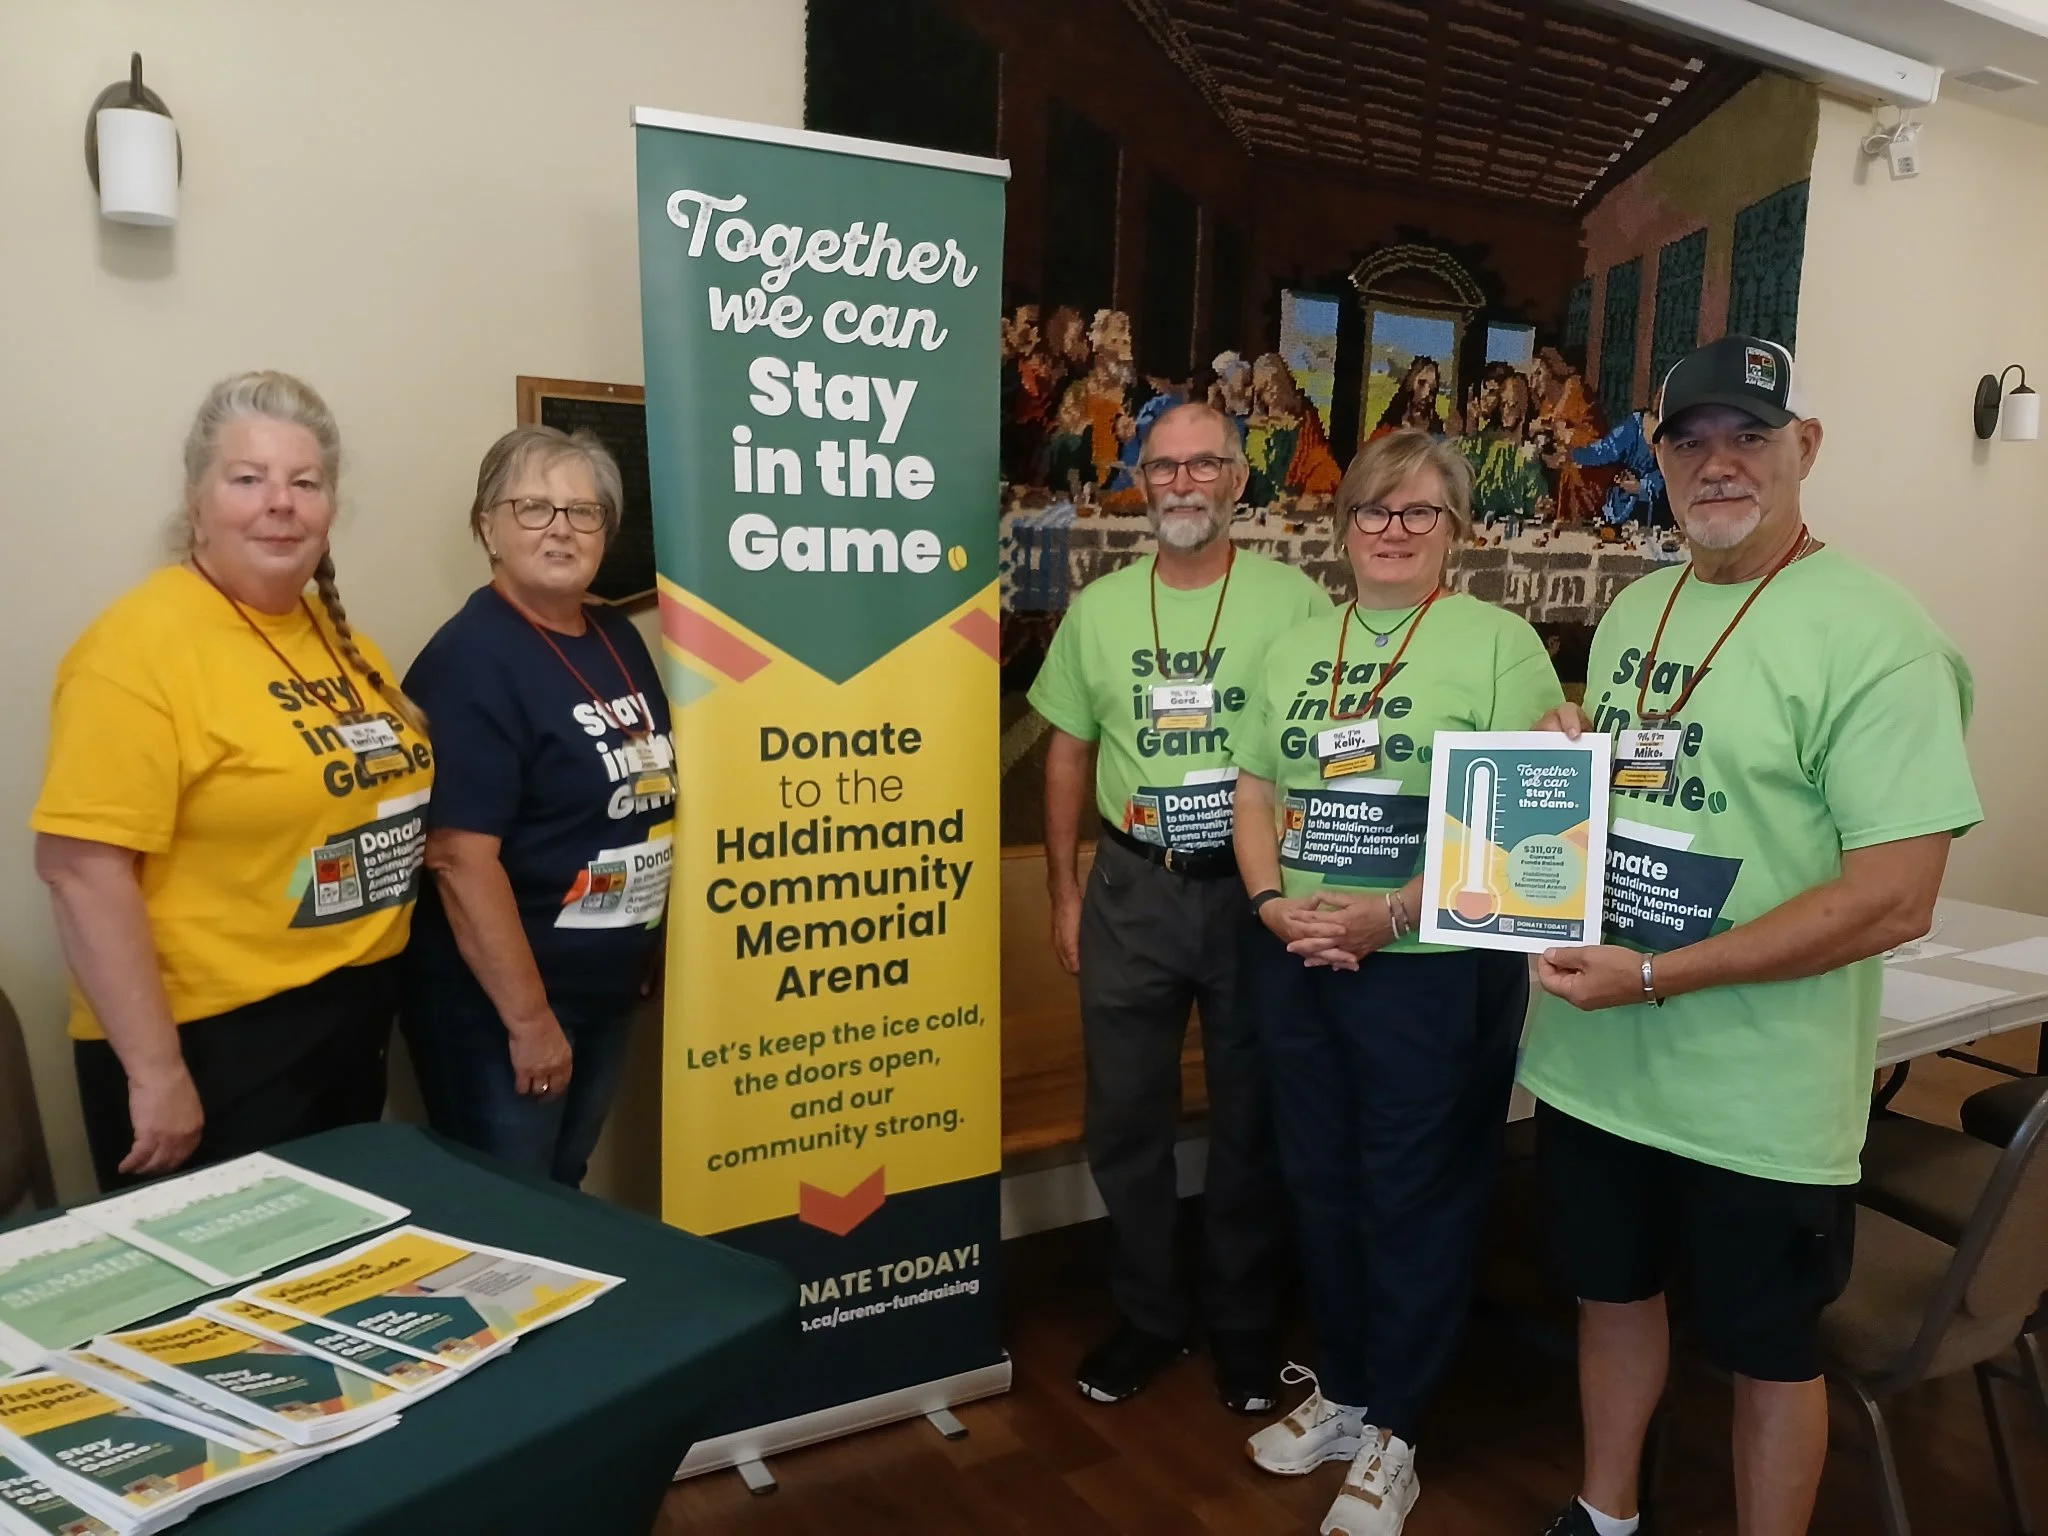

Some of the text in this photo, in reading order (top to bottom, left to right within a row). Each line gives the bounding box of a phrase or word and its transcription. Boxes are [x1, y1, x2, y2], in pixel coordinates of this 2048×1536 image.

[667, 189, 978, 292] Together
[708, 286, 948, 351] we can
[748, 356, 918, 443] Stay
[732, 425, 935, 500] in the
[1131, 647, 1226, 685] Stay
[1306, 660, 1408, 692] Stay
[1612, 647, 1712, 696] Stay
[268, 676, 360, 713] Stay
[1286, 690, 1328, 721] in
[1338, 692, 1413, 720] the
[573, 692, 656, 737] Stay
[760, 722, 922, 762] Donate
[1136, 727, 1231, 759] Gam
[1280, 726, 1414, 761] Ge
[1517, 763, 1579, 779] Together
[1521, 778, 1570, 788] we can
[779, 769, 904, 809] to the
[1518, 798, 1539, 808] the
[1526, 787, 1566, 800] Stay in
[1166, 808, 1233, 823] to the Haldim
[1167, 819, 1230, 833] Community
[1307, 819, 1393, 834] to the Haldimand
[1309, 798, 1383, 821] Donate
[716, 808, 964, 865] Haldimand
[1170, 832, 1201, 843] Arena
[1304, 841, 1399, 859] Arena Fundraising
[1306, 830, 1419, 845] Community Memorial
[1302, 851, 1352, 868] Campaign
[706, 854, 974, 914] Community
[1604, 884, 1713, 919] munity Memorial
[1611, 871, 1680, 900] Haldimand
[736, 901, 947, 960] Memorial
[1516, 921, 1543, 929] DONATE
[1611, 898, 1685, 931] Fundraising
[775, 958, 909, 1002] Arena
[686, 1004, 986, 1070] Let’s keep the ice cold,
[734, 1048, 941, 1097] the doors open,
[790, 1085, 895, 1120] and our
[706, 1107, 965, 1172] community strong.
[800, 1243, 980, 1308] NATE TODAY!
[801, 1278, 980, 1333] .ca/arena-fundraising
